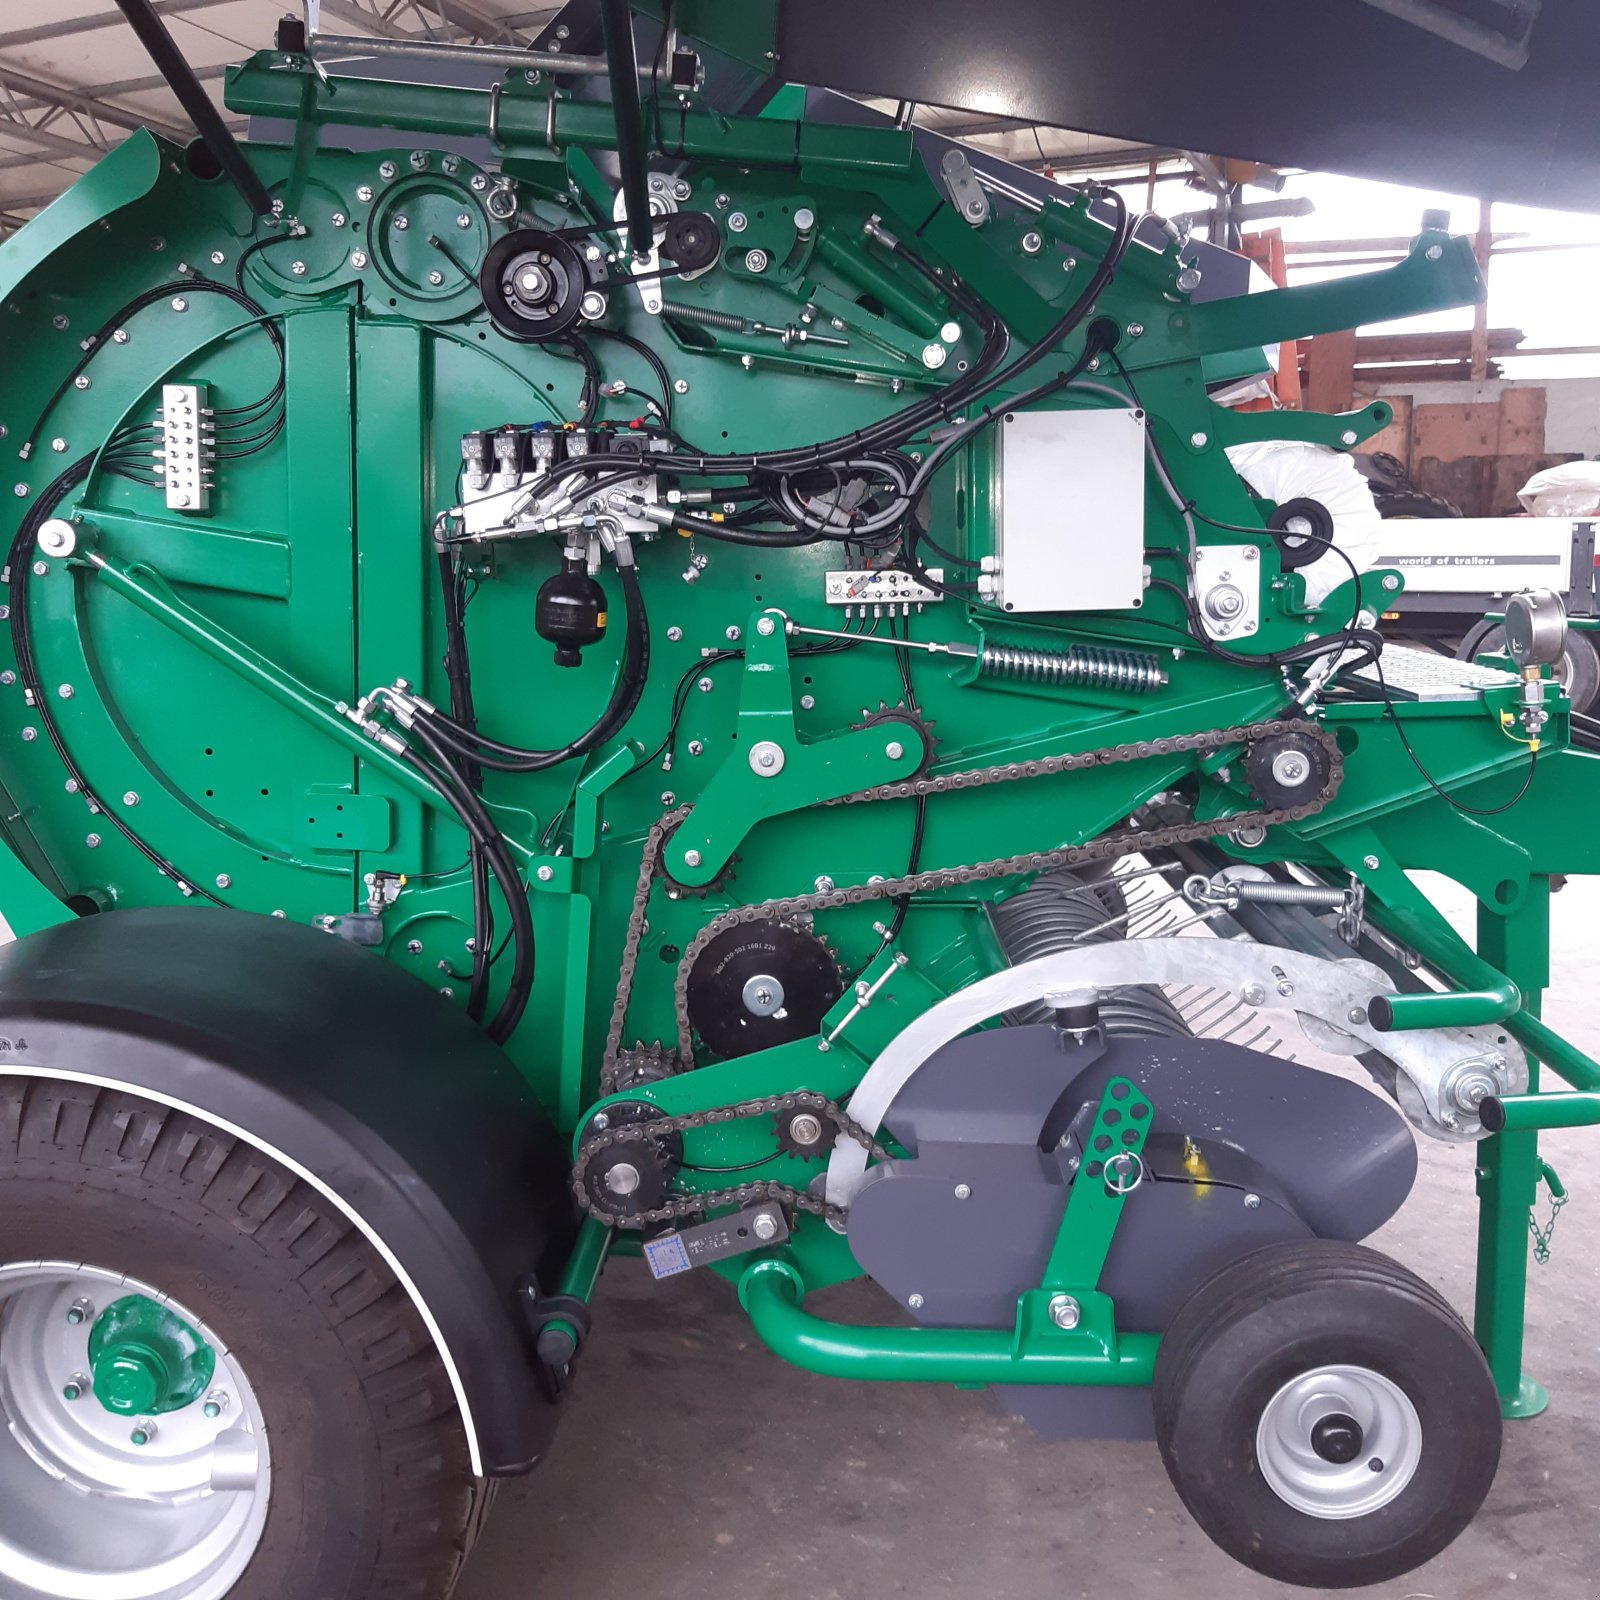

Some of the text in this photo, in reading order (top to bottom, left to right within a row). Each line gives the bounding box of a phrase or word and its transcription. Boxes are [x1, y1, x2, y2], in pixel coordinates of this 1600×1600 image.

[1398, 556, 1495, 565] world of trailers
